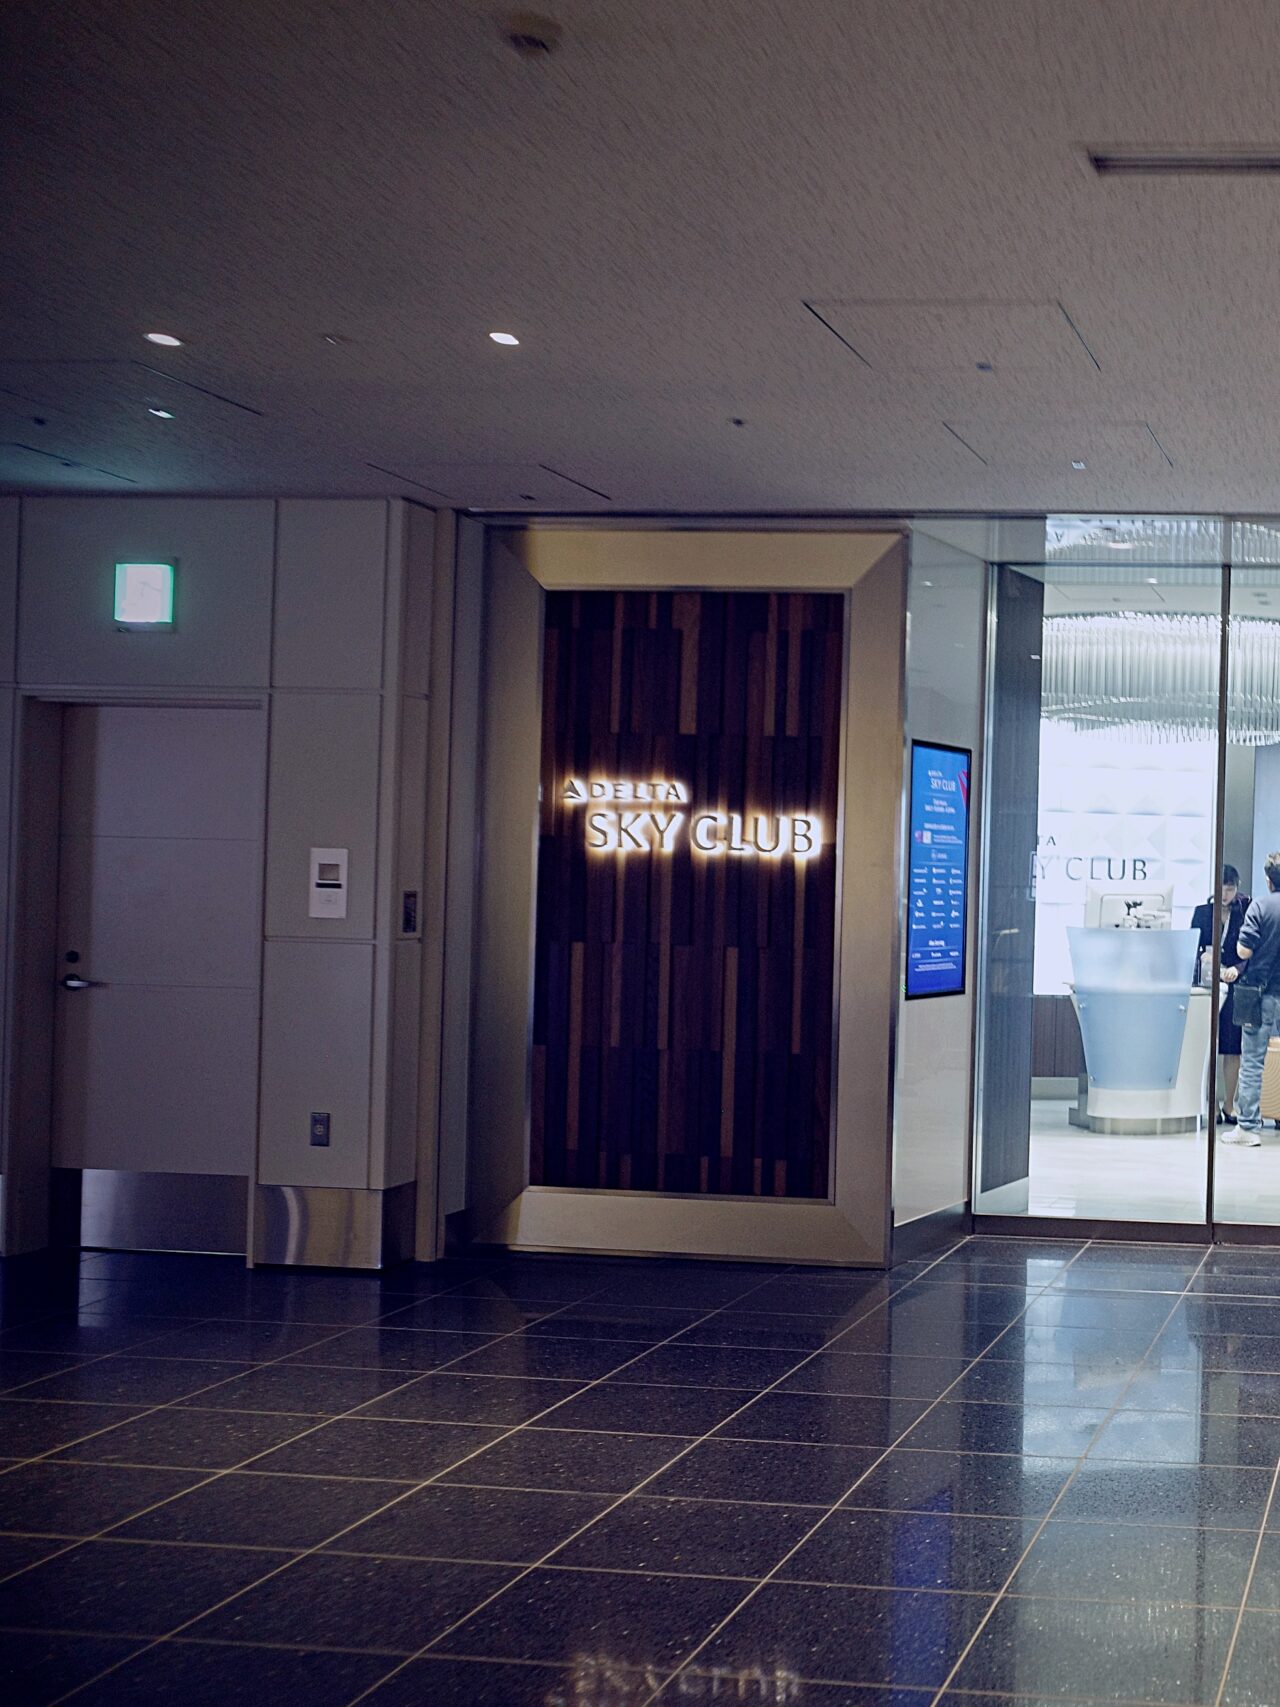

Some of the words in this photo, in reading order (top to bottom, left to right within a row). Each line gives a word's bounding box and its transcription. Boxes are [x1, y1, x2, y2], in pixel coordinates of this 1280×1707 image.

[589, 781, 685, 801] DELTA
[587, 811, 684, 850] SKY
[690, 813, 814, 854] CLUB
[1065, 856, 1148, 881] CLUB
